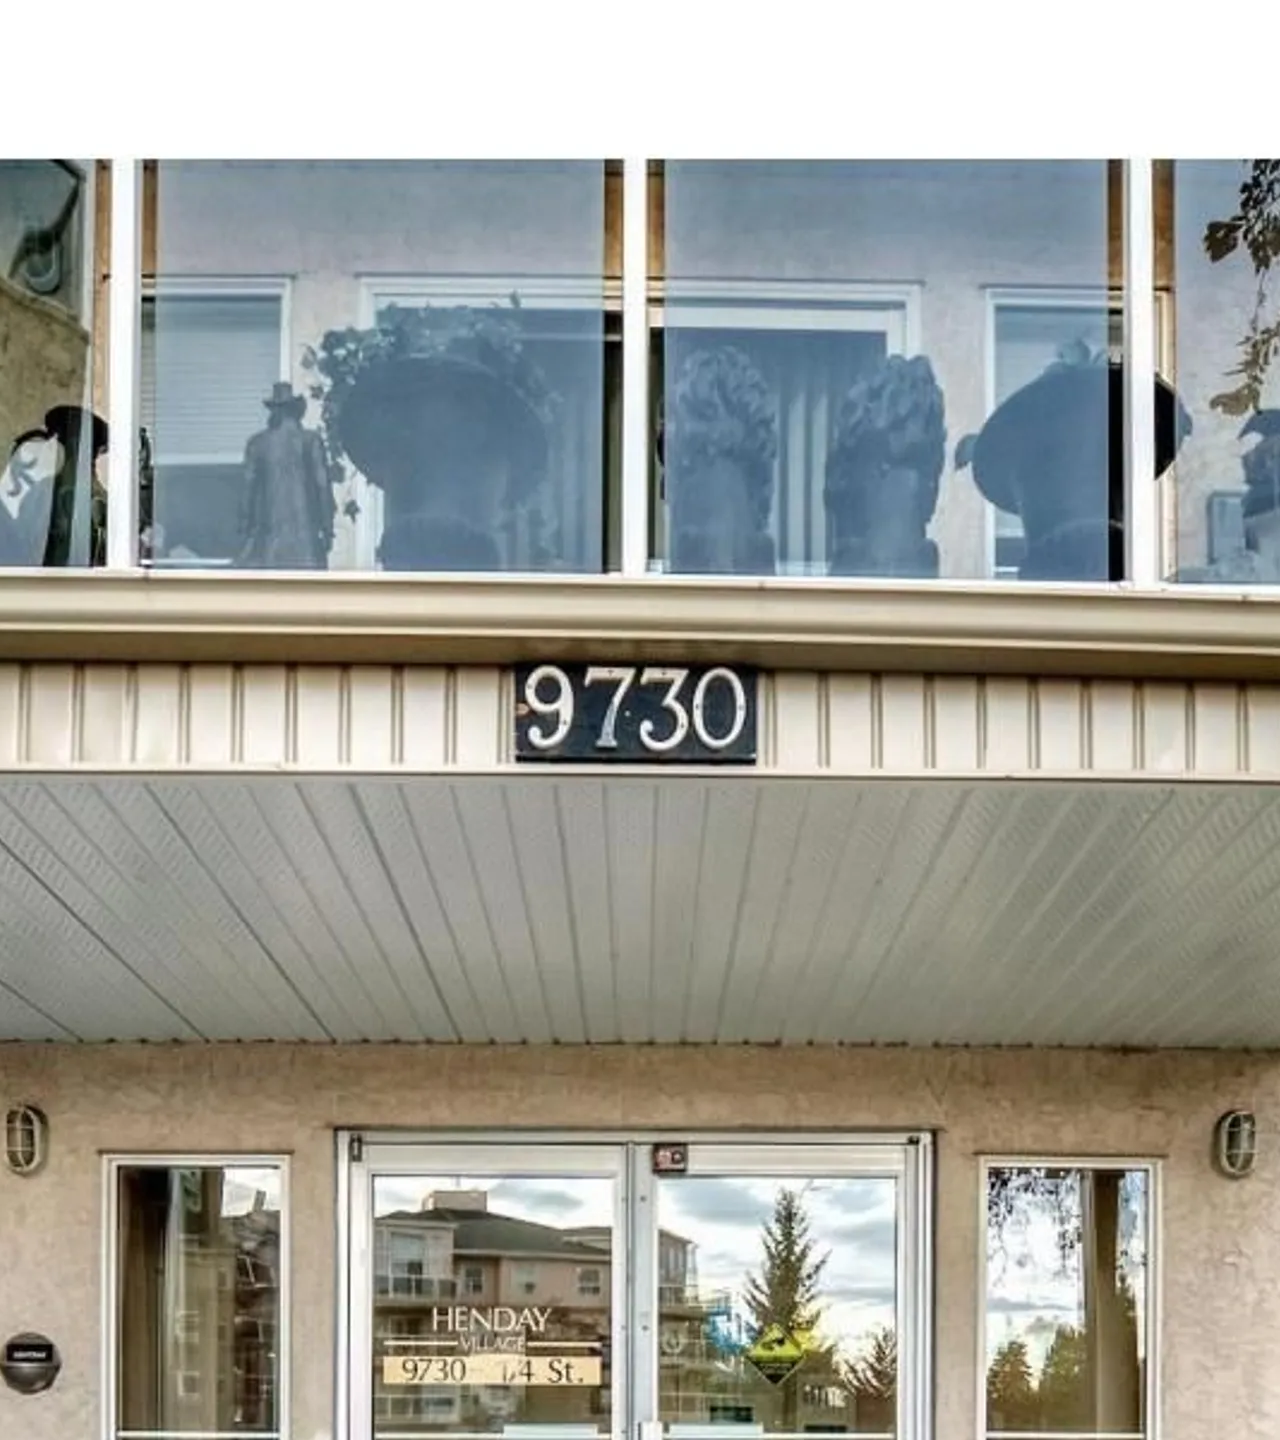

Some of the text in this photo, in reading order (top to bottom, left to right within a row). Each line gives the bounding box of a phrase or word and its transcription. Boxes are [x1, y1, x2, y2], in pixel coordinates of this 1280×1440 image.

[524, 664, 747, 751] 9730
[432, 1306, 552, 1332] HENDAY
[460, 1335, 525, 1352] VILLAGE
[402, 1358, 467, 1382] 9730
[547, 1358, 584, 1383] St.
